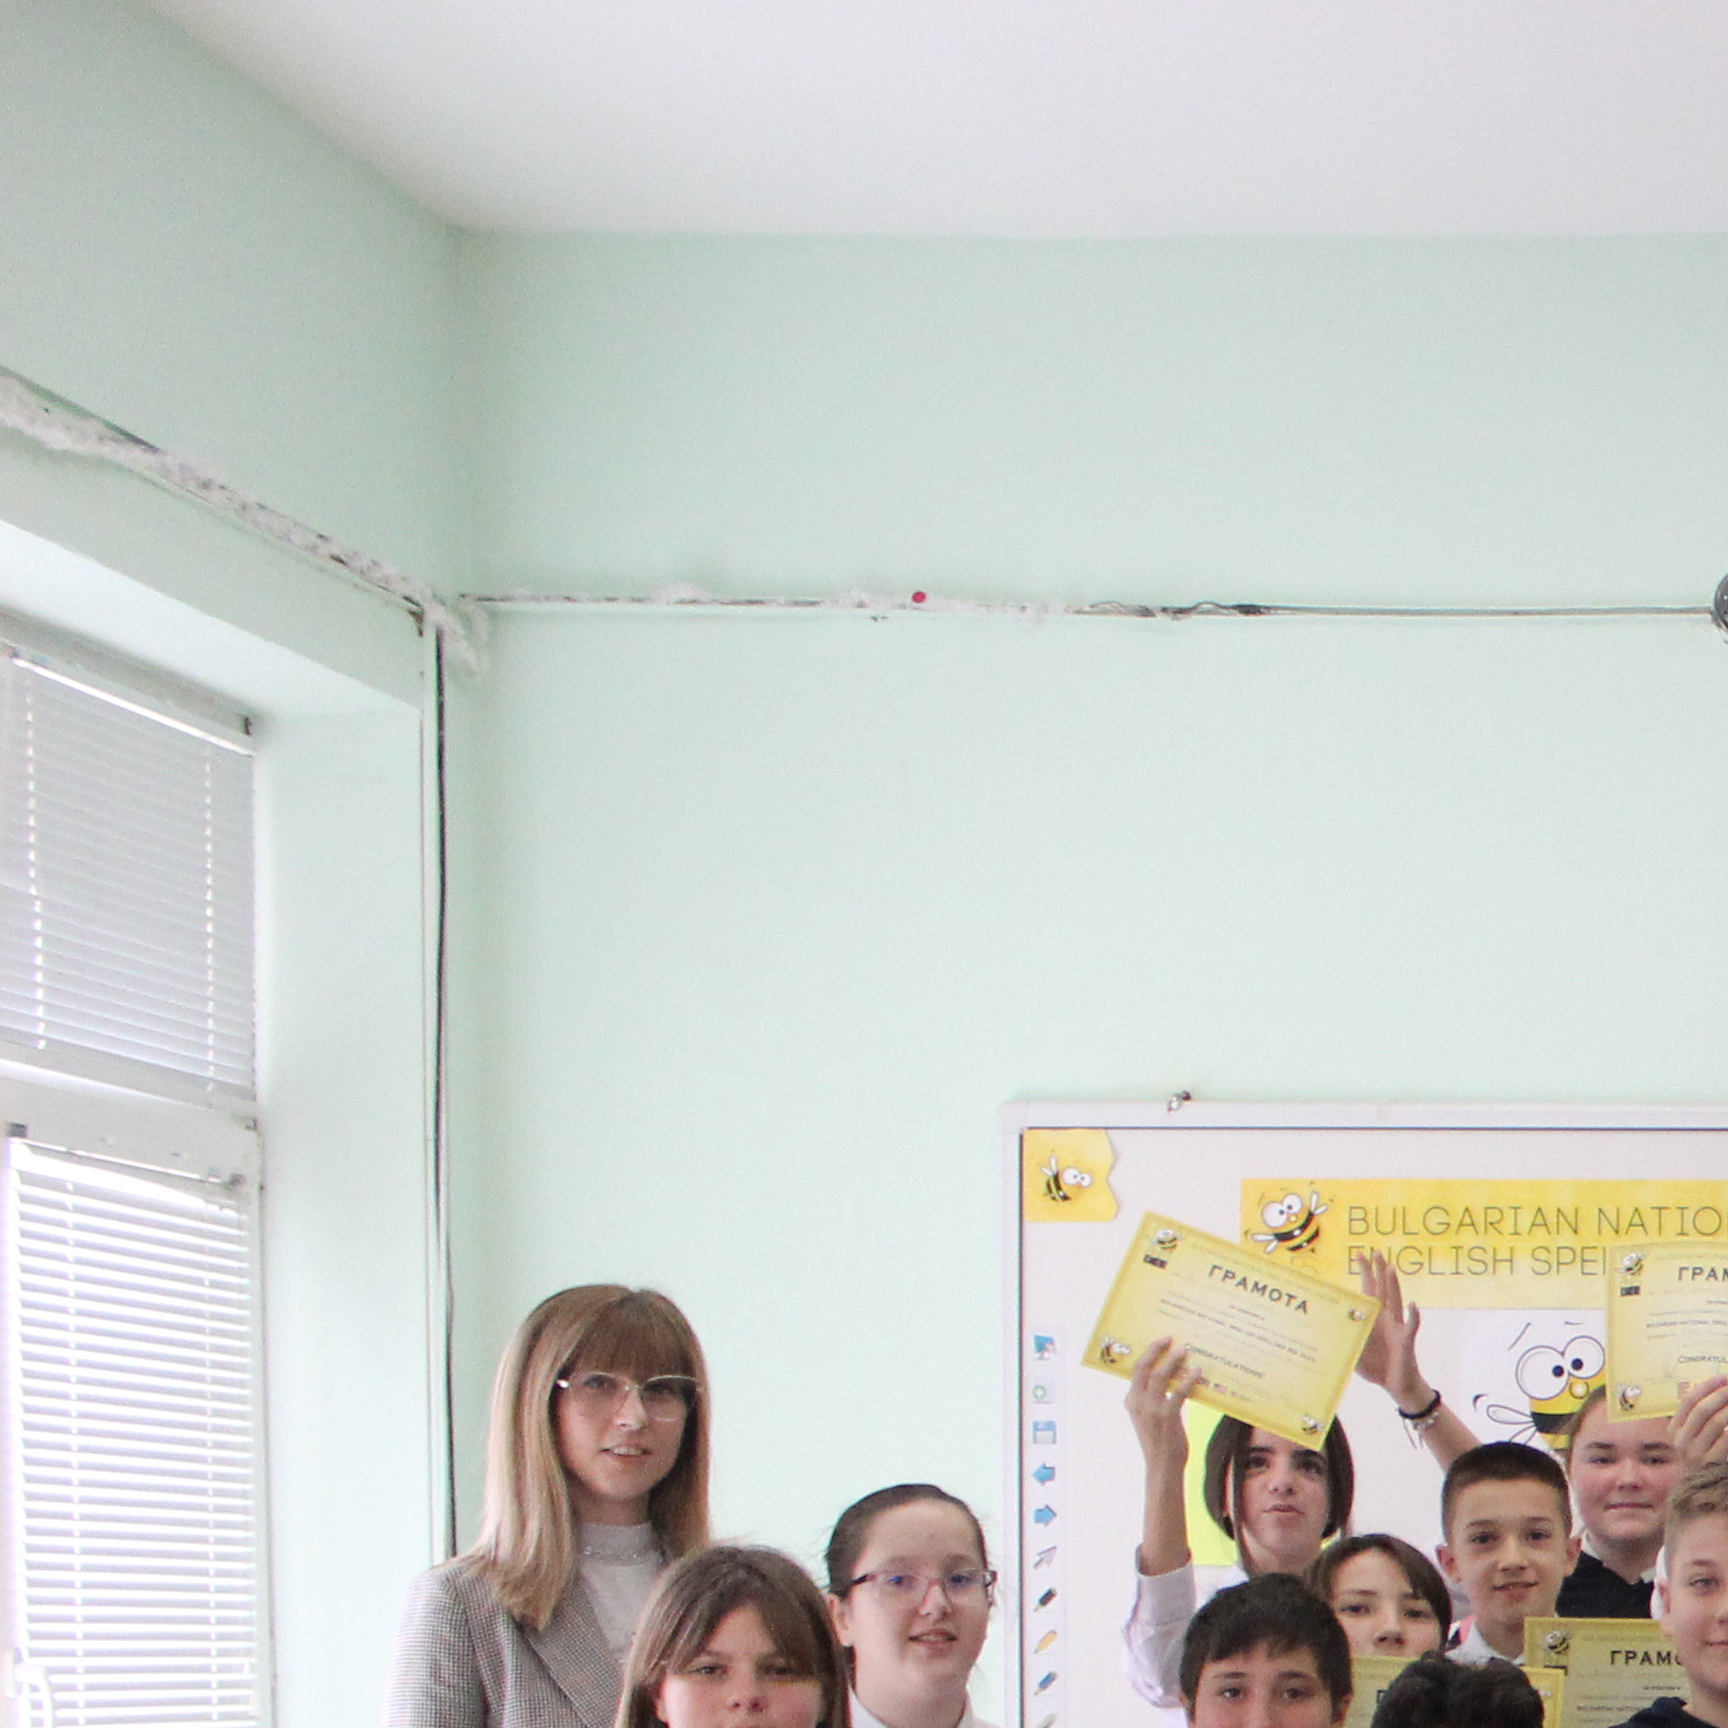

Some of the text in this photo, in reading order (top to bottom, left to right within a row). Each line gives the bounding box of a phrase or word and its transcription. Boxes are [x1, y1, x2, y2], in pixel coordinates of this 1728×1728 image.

[1347, 1205, 1579, 1237] BULGARIAN
[1207, 1264, 1310, 1316] ГРАМОТА
[1609, 1649, 1682, 1666] ГРАМ
